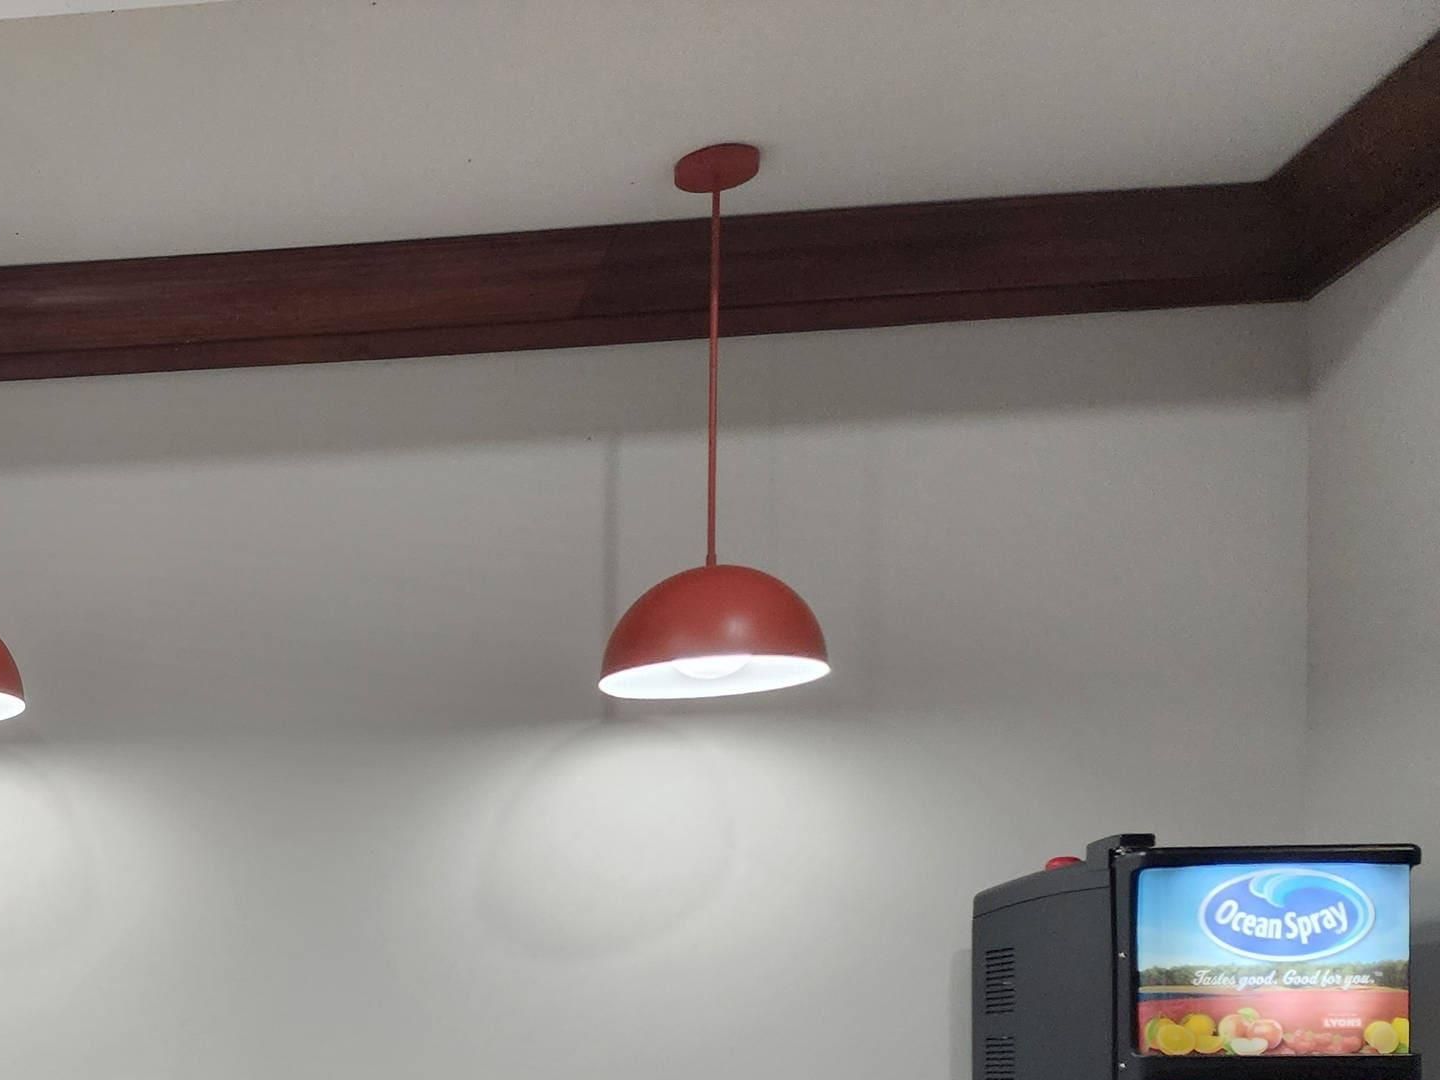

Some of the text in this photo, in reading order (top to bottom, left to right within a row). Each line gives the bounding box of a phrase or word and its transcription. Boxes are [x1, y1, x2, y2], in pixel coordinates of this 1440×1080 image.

[1215, 899, 1348, 944] Ocean Spray
[1192, 969, 1236, 985] Tastes
[1236, 970, 1277, 991] good.
[1282, 969, 1321, 985] Good
[1319, 970, 1342, 987] for
